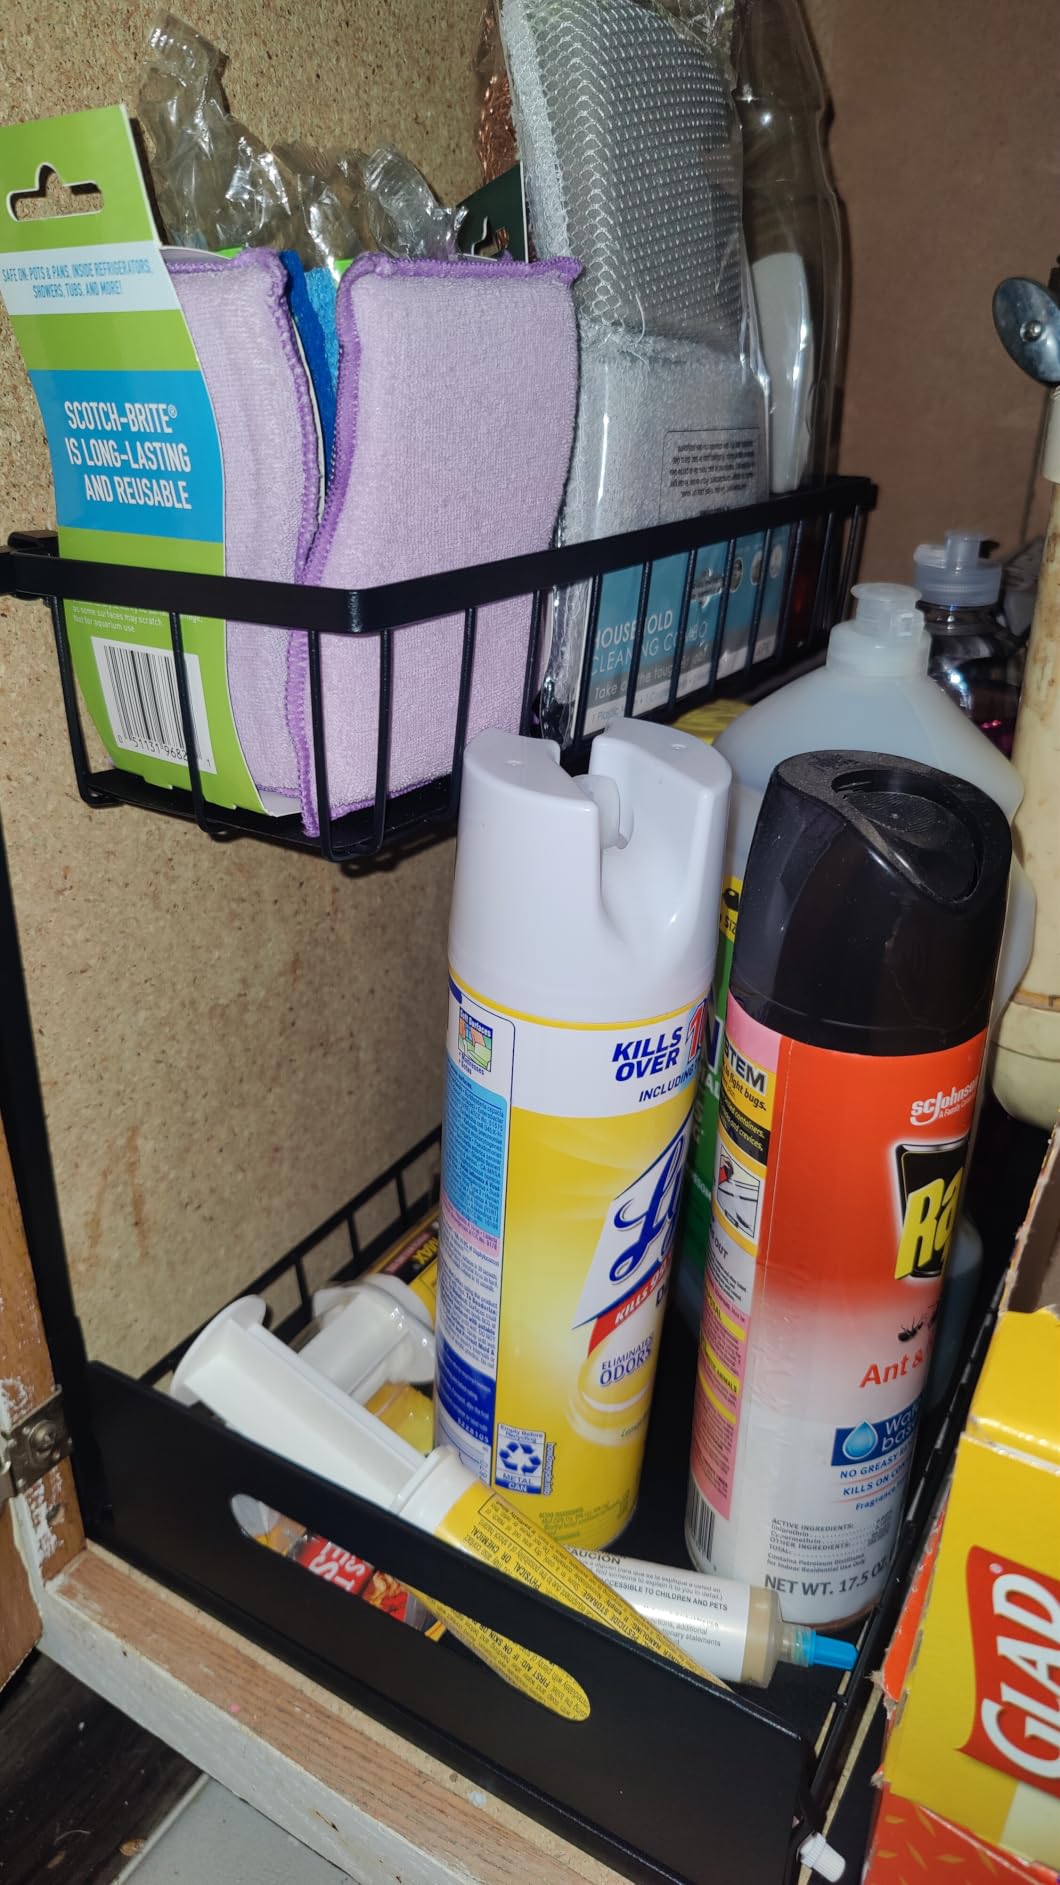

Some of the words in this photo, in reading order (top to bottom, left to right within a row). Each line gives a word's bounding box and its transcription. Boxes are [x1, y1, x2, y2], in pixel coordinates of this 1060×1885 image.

[2, 267, 17, 282] SAFE
[29, 265, 45, 280] POTS
[72, 262, 94, 278] INSIDE
[33, 281, 66, 299] SHOWERS,
[66, 281, 85, 297] TUBS,
[86, 281, 99, 295] AND
[101, 280, 122, 295] MORE!
[65, 437, 82, 465] IS
[81, 438, 191, 473] LONG-LASTING
[84, 474, 113, 503] AND
[114, 476, 192, 510] REUSABLE
[98, 608, 124, 620] surfaces
[124, 614, 138, 625] may
[596, 610, 673, 649] OUSEOLD
[591, 638, 660, 677] CLEANNG
[595, 683, 617, 700] Take
[612, 1026, 683, 1062] KILLS
[615, 1047, 680, 1082] OVER
[729, 1070, 744, 1094] fight
[743, 1087, 767, 1112] bugs.
[615, 1287, 648, 1326] KILLS
[600, 1347, 651, 1386] ODORS
[859, 1355, 910, 1388] Ant
[911, 1348, 924, 1368] &
[840, 1469, 857, 1479] NO
[860, 1453, 897, 1476] GREASY
[503, 1472, 533, 1484] METAL
[508, 1482, 528, 1492] CAN
[843, 1481, 873, 1496] KILLS
[876, 1474, 890, 1486] ON
[855, 1486, 897, 1511] Fragrance
[772, 1518, 798, 1529] ACTIVE
[801, 1523, 854, 1532] INGREDIENTS:
[469, 1525, 500, 1554] CHEMICAL
[770, 1537, 796, 1549] OTHER
[500, 1551, 511, 1563] OR
[512, 1561, 542, 1589] PHYSICAL
[801, 1565, 839, 1573] Residential
[644, 1578, 669, 1591] explain
[765, 1574, 799, 1594] NET
[802, 1582, 834, 1597] WT.
[839, 1570, 870, 1593] 17.5
[648, 1587, 655, 1596] TO
[655, 1590, 692, 1604] CHILDREN
[692, 1597, 708, 1607] AND
[708, 1599, 729, 1612] PETS
[488, 1631, 503, 1645] SKIN
[608, 1613, 639, 1641] PESTICIDE
[676, 1621, 709, 1636] additional
[502, 1643, 513, 1654] ON
[685, 1630, 722, 1648] statements
[511, 1652, 519, 1660] IF
[532, 1669, 550, 1687] FIRST
[981, 1573, 1060, 1780] GLAD
